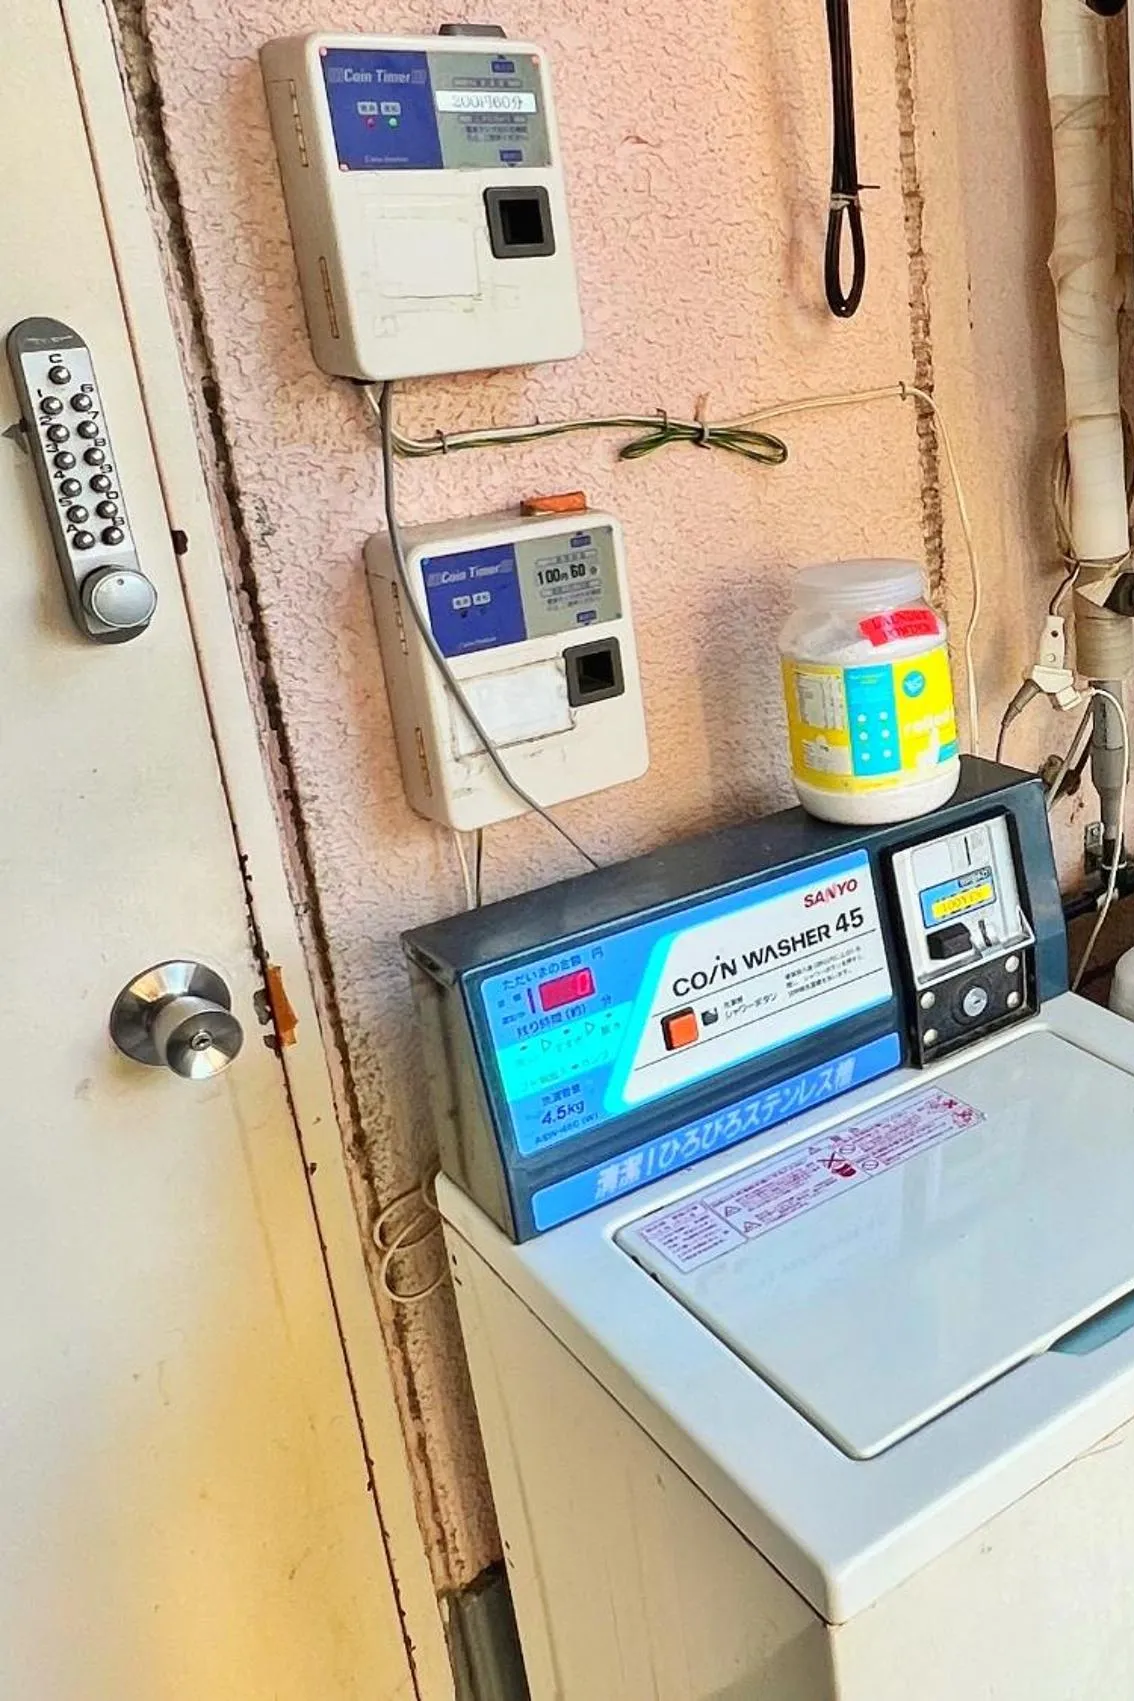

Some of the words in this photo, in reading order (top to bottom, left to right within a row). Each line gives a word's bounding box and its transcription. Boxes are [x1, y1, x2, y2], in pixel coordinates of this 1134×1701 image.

[344, 67, 372, 83] Coin
[376, 69, 411, 83] Timer
[48, 353, 63, 364] C
[37, 388, 43, 398] 1
[39, 415, 54, 426] 2
[87, 410, 100, 420] 7
[53, 470, 66, 479] 4
[570, 563, 586, 578] 60
[803, 878, 858, 908] SANYO
[741, 923, 831, 969] WASHER
[835, 906, 865, 933] 45
[541, 1100, 585, 1125] 4.5kg
